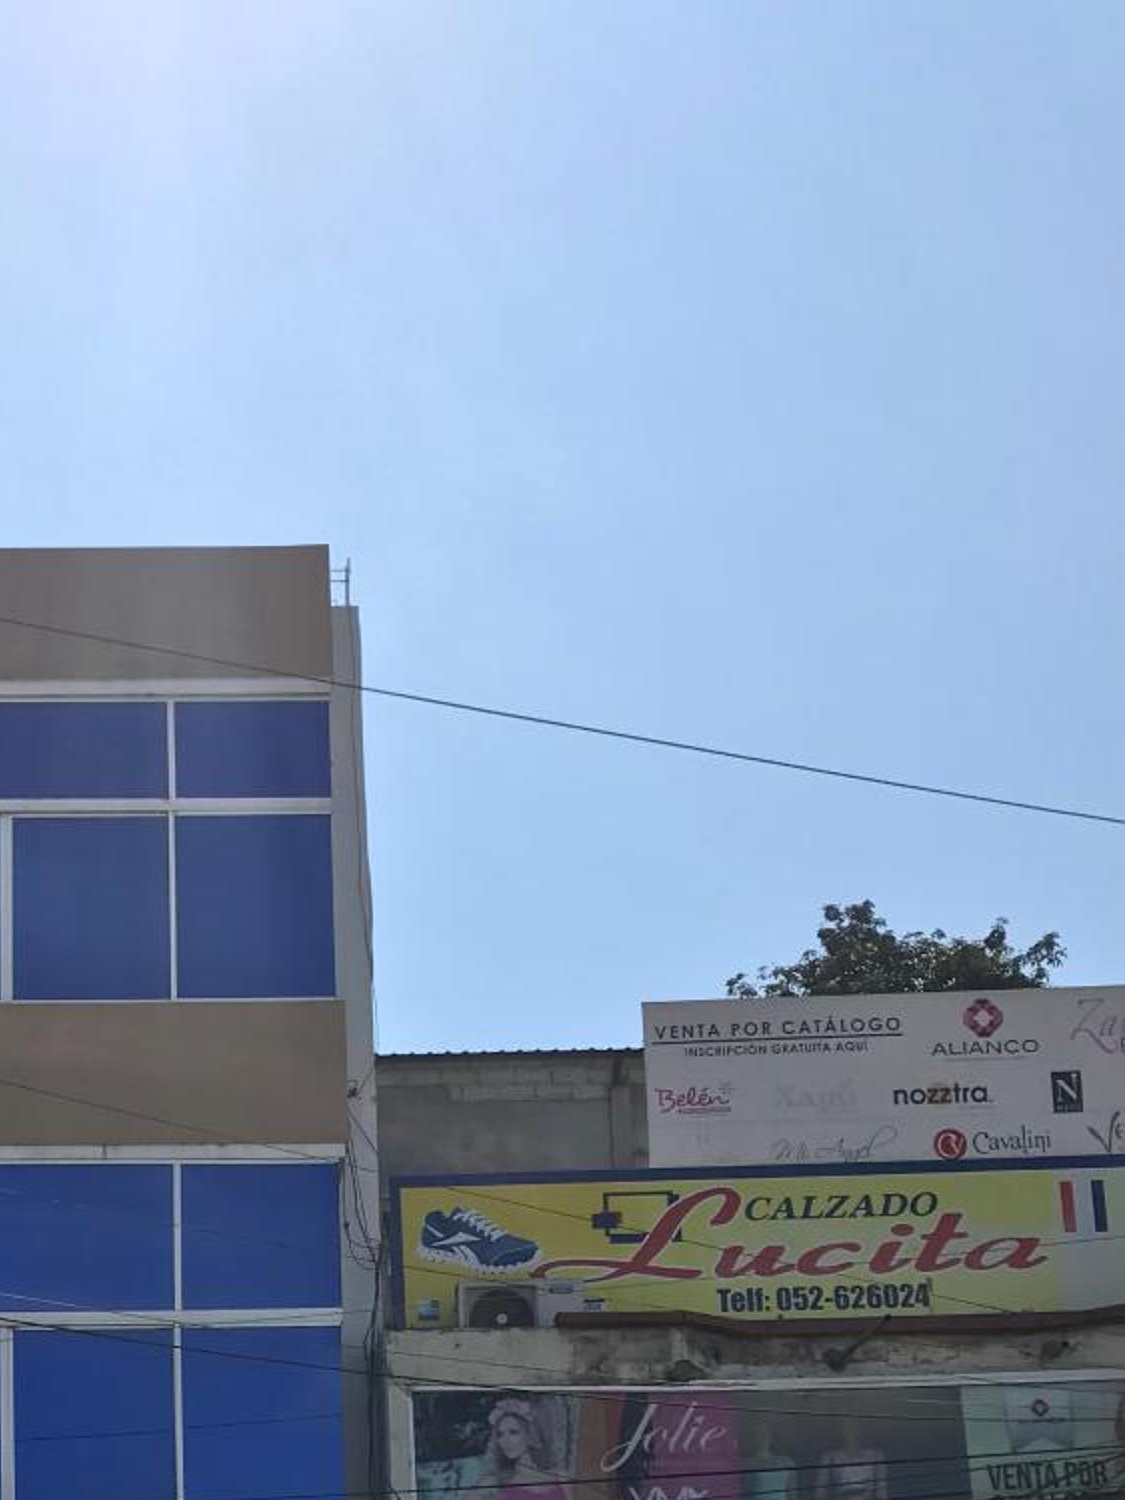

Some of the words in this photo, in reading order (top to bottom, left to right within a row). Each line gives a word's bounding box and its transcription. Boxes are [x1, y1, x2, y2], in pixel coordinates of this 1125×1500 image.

[654, 1023, 721, 1040] VENTA
[730, 1020, 772, 1037] POR
[781, 1014, 901, 1034] CATÁLOGO
[771, 1041, 830, 1055] GRATUITA
[931, 1039, 1040, 1057] ALIANCO
[654, 1087, 730, 1112] Belén
[893, 1083, 988, 1105] nozztra
[972, 1124, 1052, 1154] Cavalini
[744, 1192, 938, 1222] CALZADO
[531, 1187, 1048, 1282] Lucita
[716, 1287, 772, 1314] Telf:
[777, 1282, 930, 1311] 052-626024
[600, 1402, 727, 1473] Jolie
[987, 1461, 1058, 1490] VENTA
